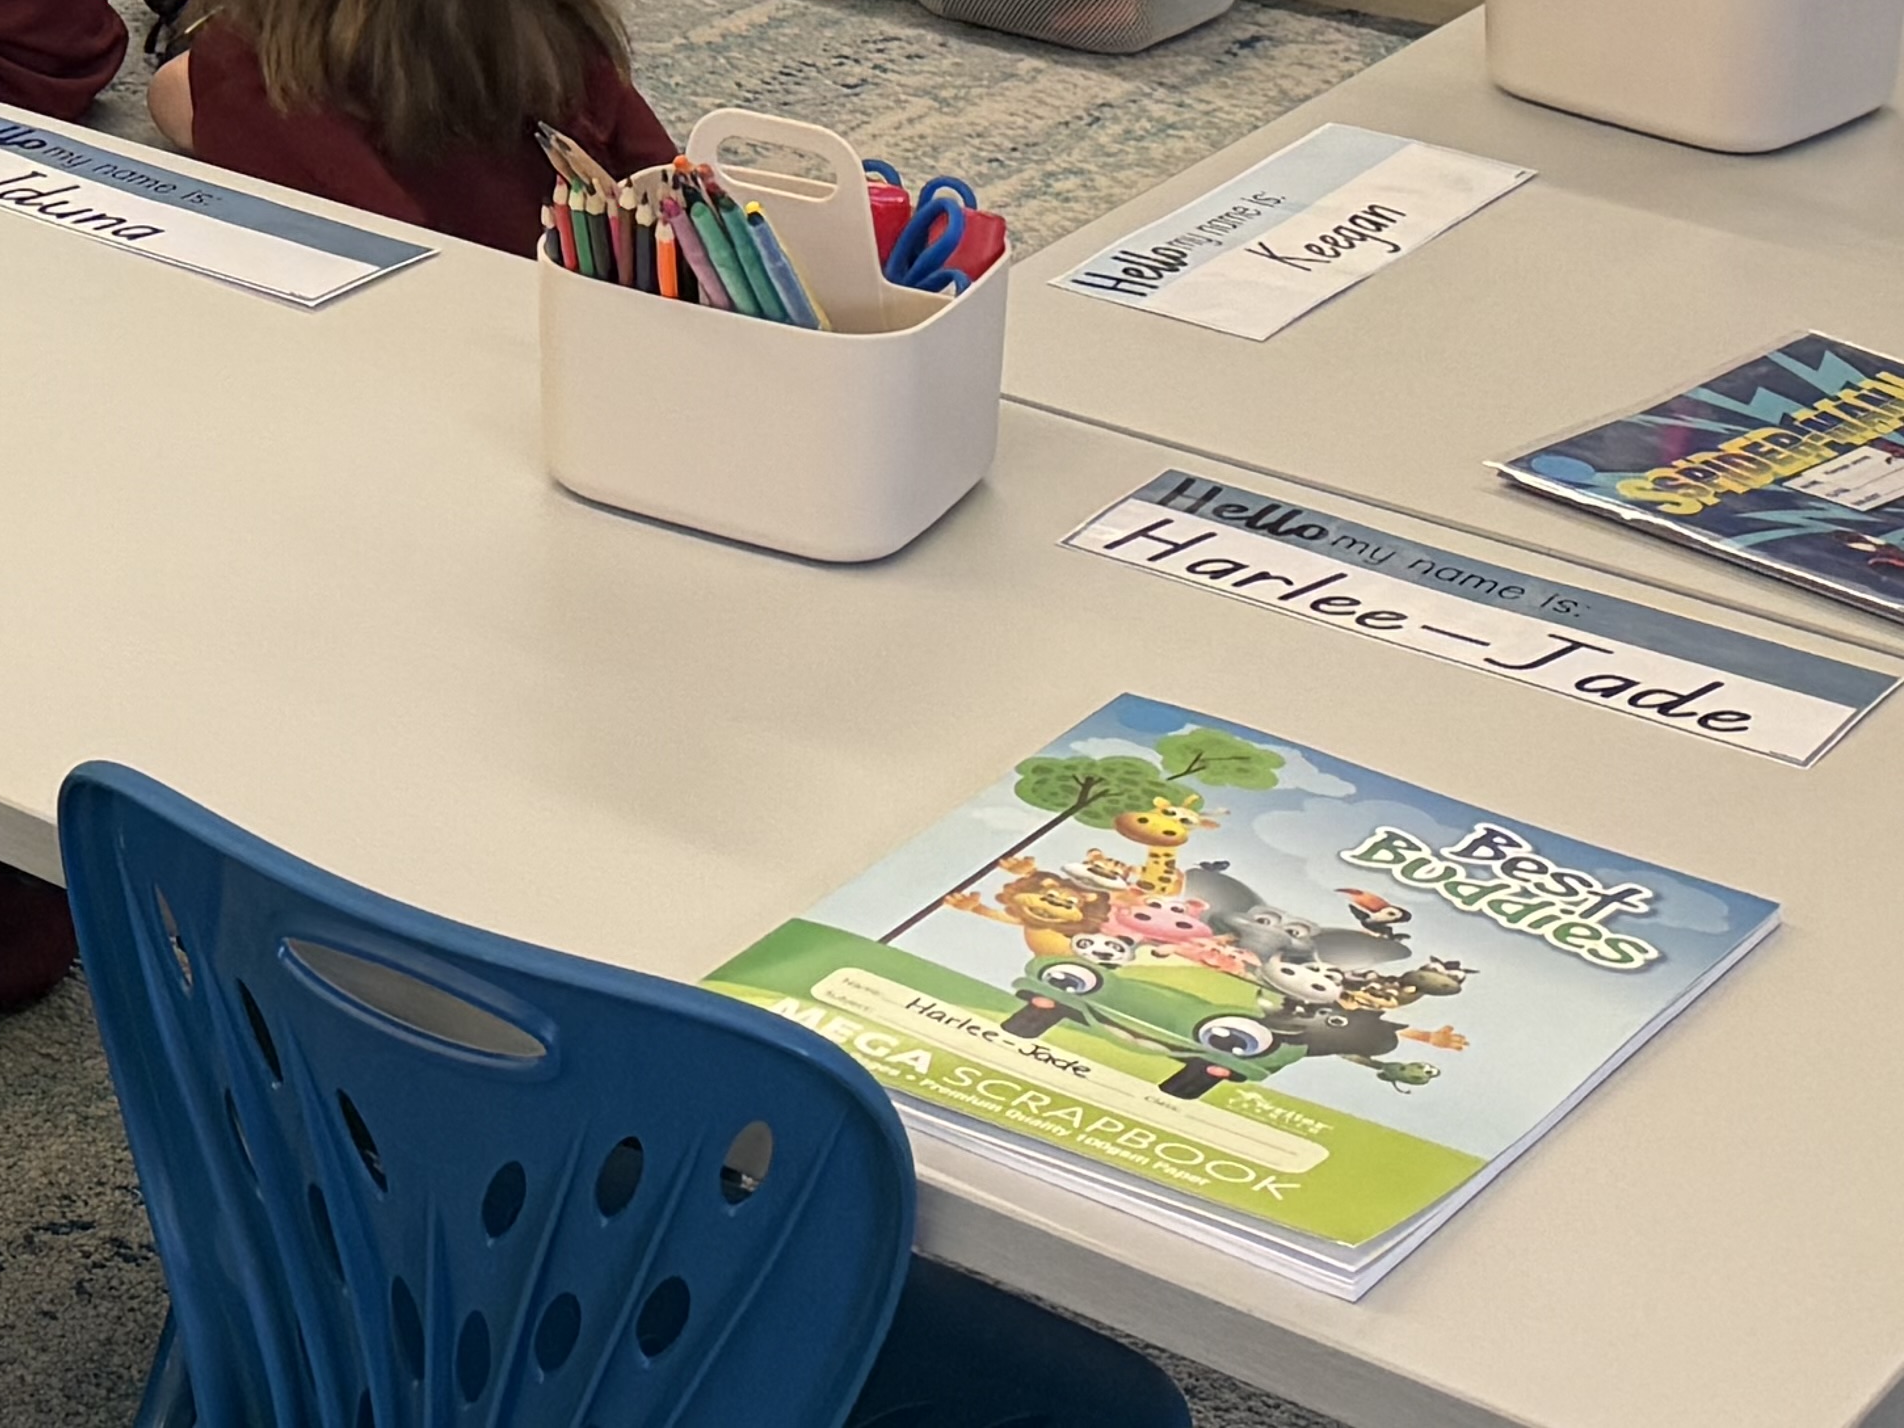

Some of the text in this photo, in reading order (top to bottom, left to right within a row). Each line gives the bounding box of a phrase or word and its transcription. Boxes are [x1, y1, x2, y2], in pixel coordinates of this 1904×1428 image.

[41, 141, 95, 172] my
[93, 155, 176, 194] name
[181, 184, 222, 210] is:
[1071, 190, 1284, 298] Hello my name is:
[1243, 202, 1408, 272] Keegan
[1154, 476, 1589, 619] Hello my name is:
[1103, 518, 1753, 736] Harlee-Jade
[1346, 831, 1653, 968] Buddies
[1446, 825, 1651, 920] Best
[904, 996, 1093, 1080] Harlee-Jade
[767, 996, 1301, 1202] MEGA SCRAPBOOK
[920, 1078, 1003, 1112] Premium
[1005, 1108, 1072, 1136] Quality
[1151, 1158, 1212, 1189] Paper
